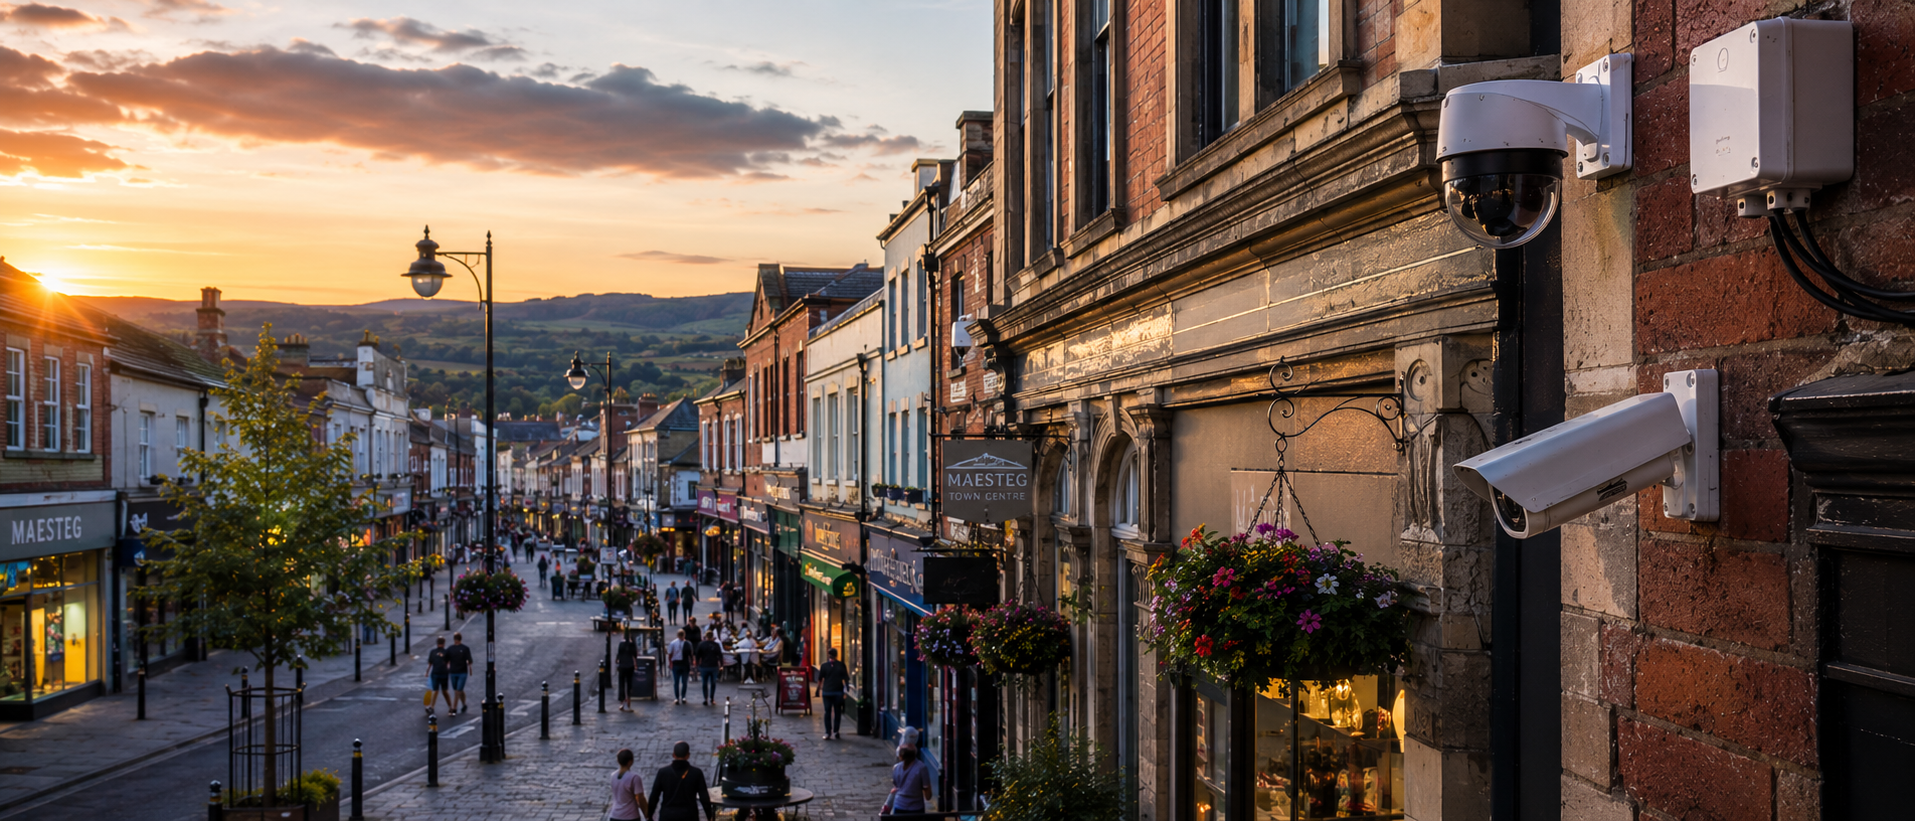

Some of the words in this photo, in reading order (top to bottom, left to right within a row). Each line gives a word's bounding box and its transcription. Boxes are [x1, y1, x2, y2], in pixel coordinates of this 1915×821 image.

[948, 473, 1028, 486] MAESTEG
[949, 492, 981, 500] TOWN
[985, 492, 1026, 500] CENTRE
[11, 516, 82, 544] MAESTEG
